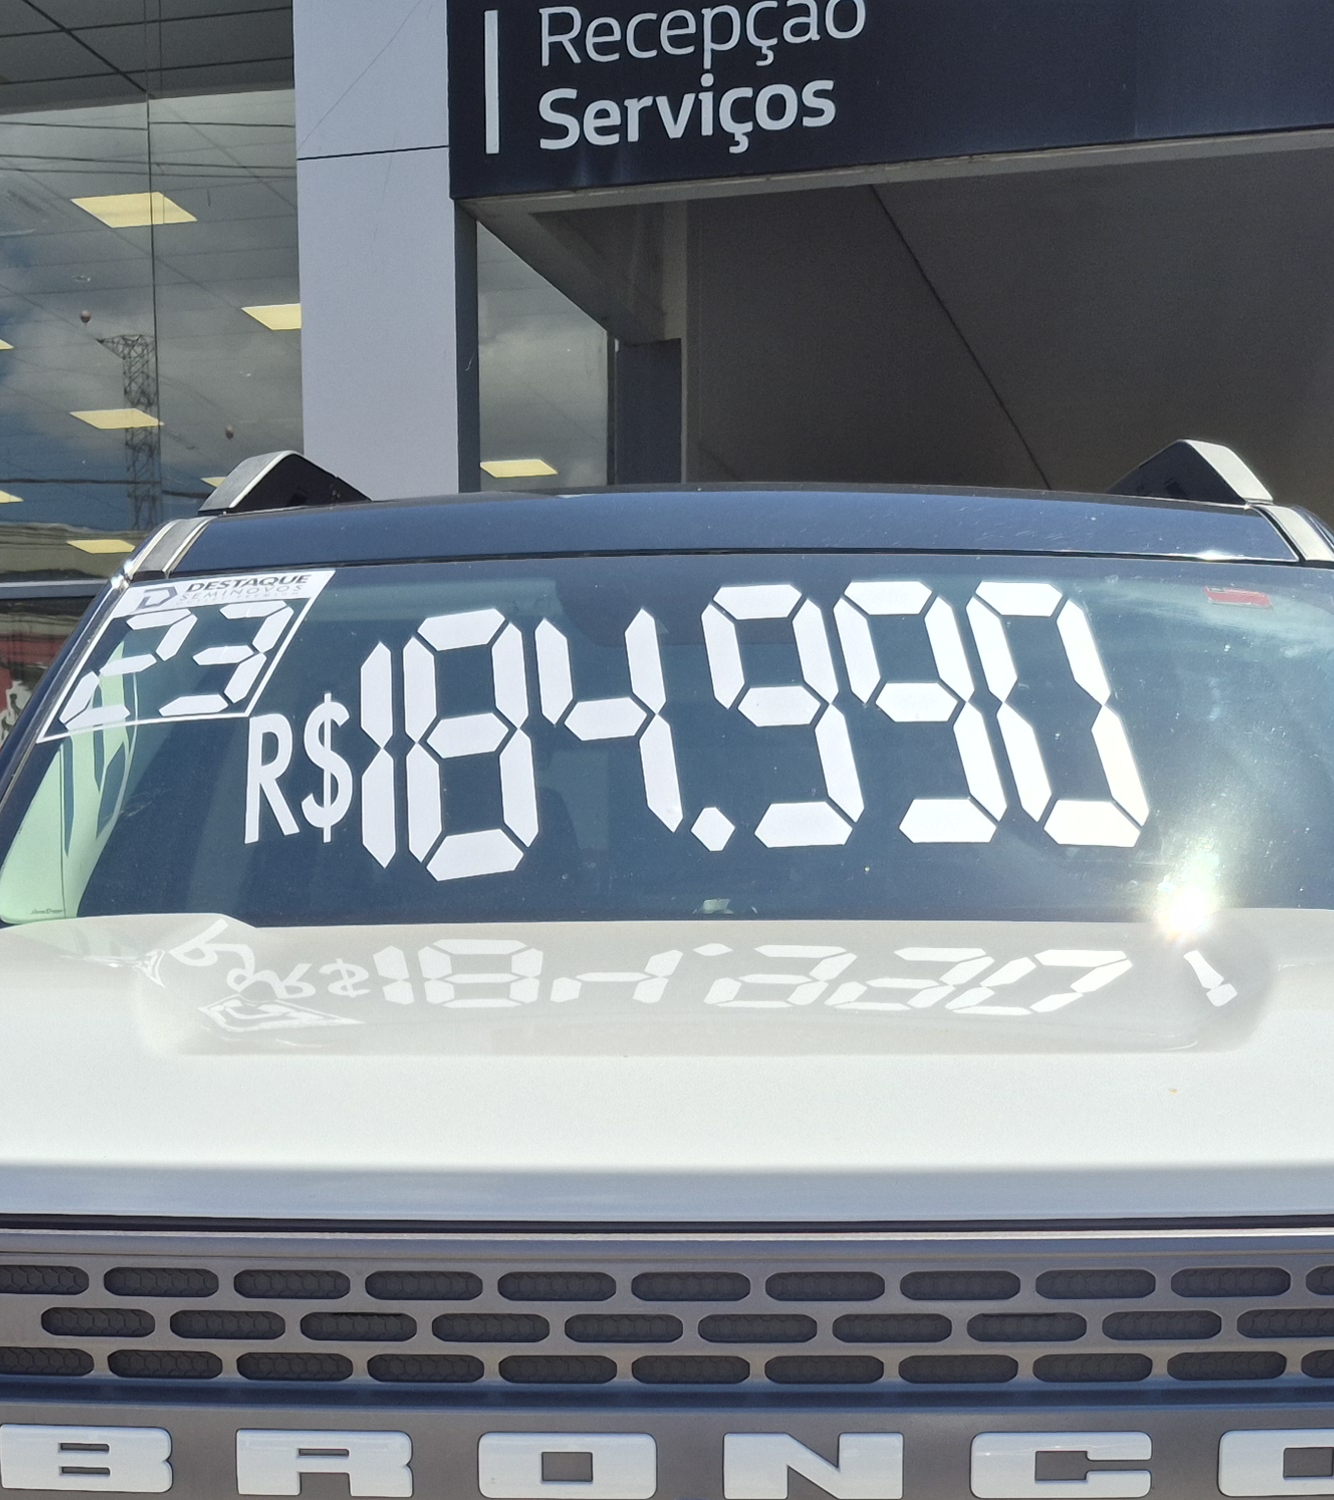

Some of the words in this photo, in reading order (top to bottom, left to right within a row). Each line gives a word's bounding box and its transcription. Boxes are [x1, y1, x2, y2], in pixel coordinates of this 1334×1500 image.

[538, 73, 837, 154] Serviços
[179, 585, 302, 601] SEMINOVOS
[186, 574, 312, 592] DESTAQUE
[59, 599, 295, 732] 23
[245, 690, 354, 845] R$
[359, 580, 1151, 882] 184.990
